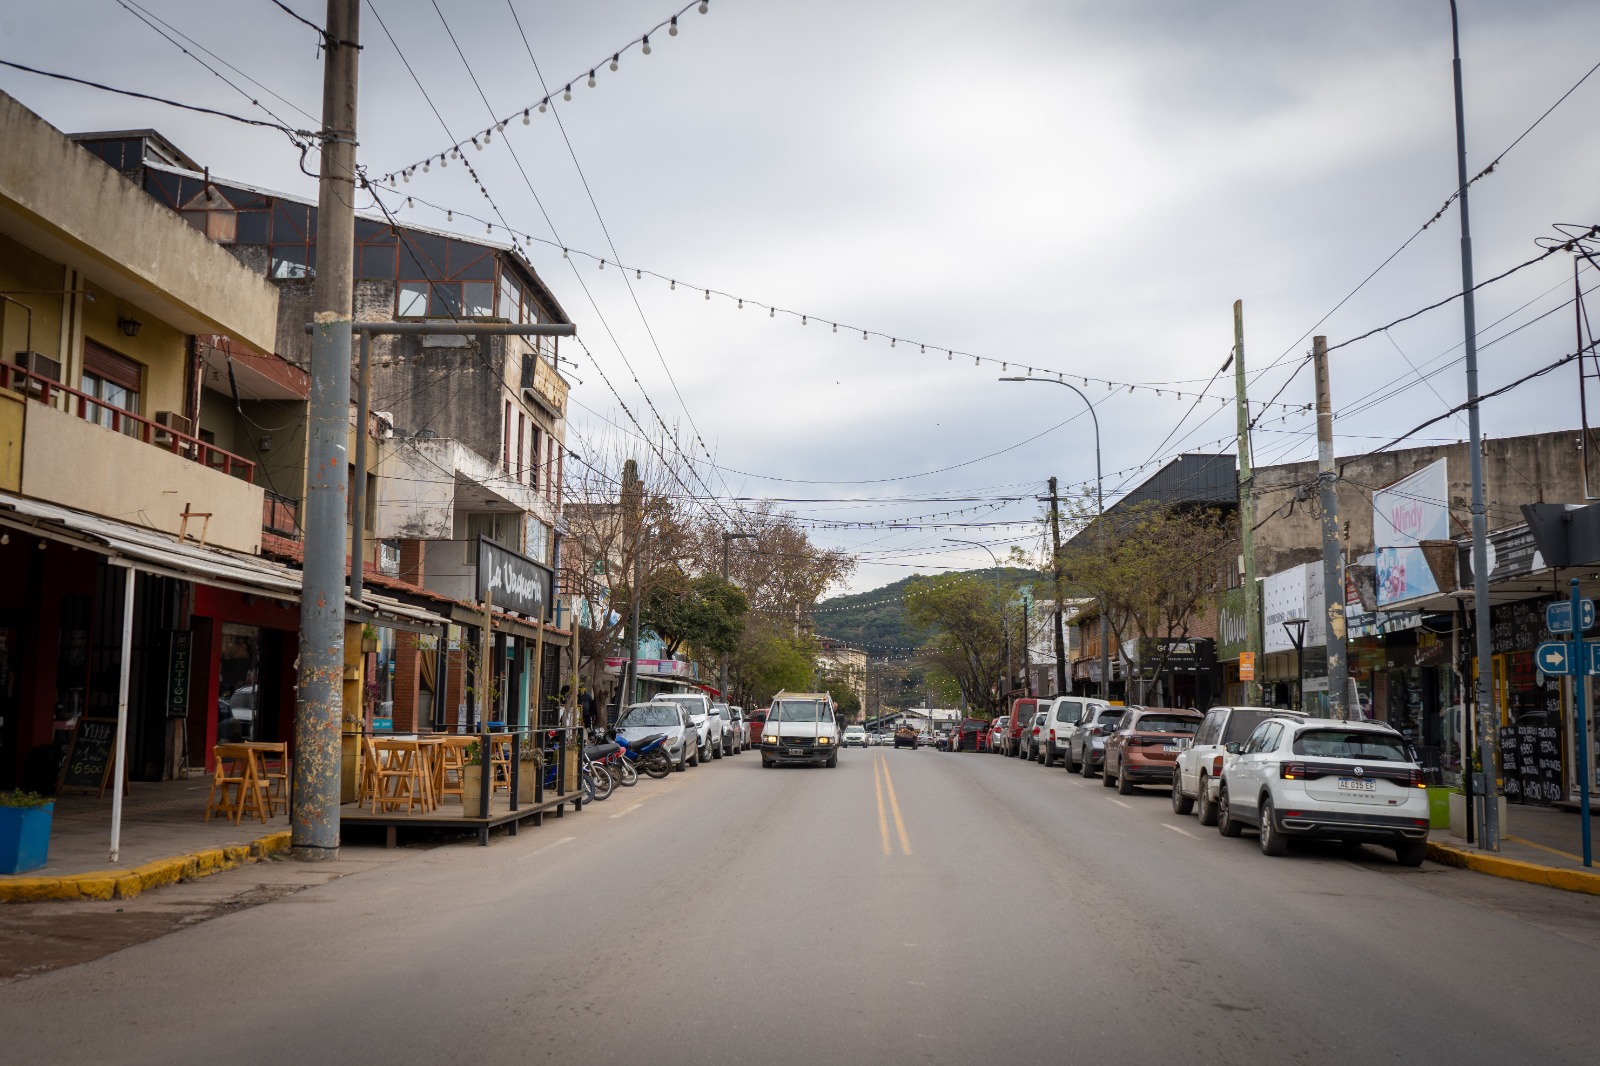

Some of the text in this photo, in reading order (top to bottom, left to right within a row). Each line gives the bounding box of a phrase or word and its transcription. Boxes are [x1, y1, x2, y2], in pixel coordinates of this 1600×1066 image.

[1392, 501, 1423, 534] Windy
[488, 551, 503, 592] La
[173, 651, 187, 704] TATTOO
